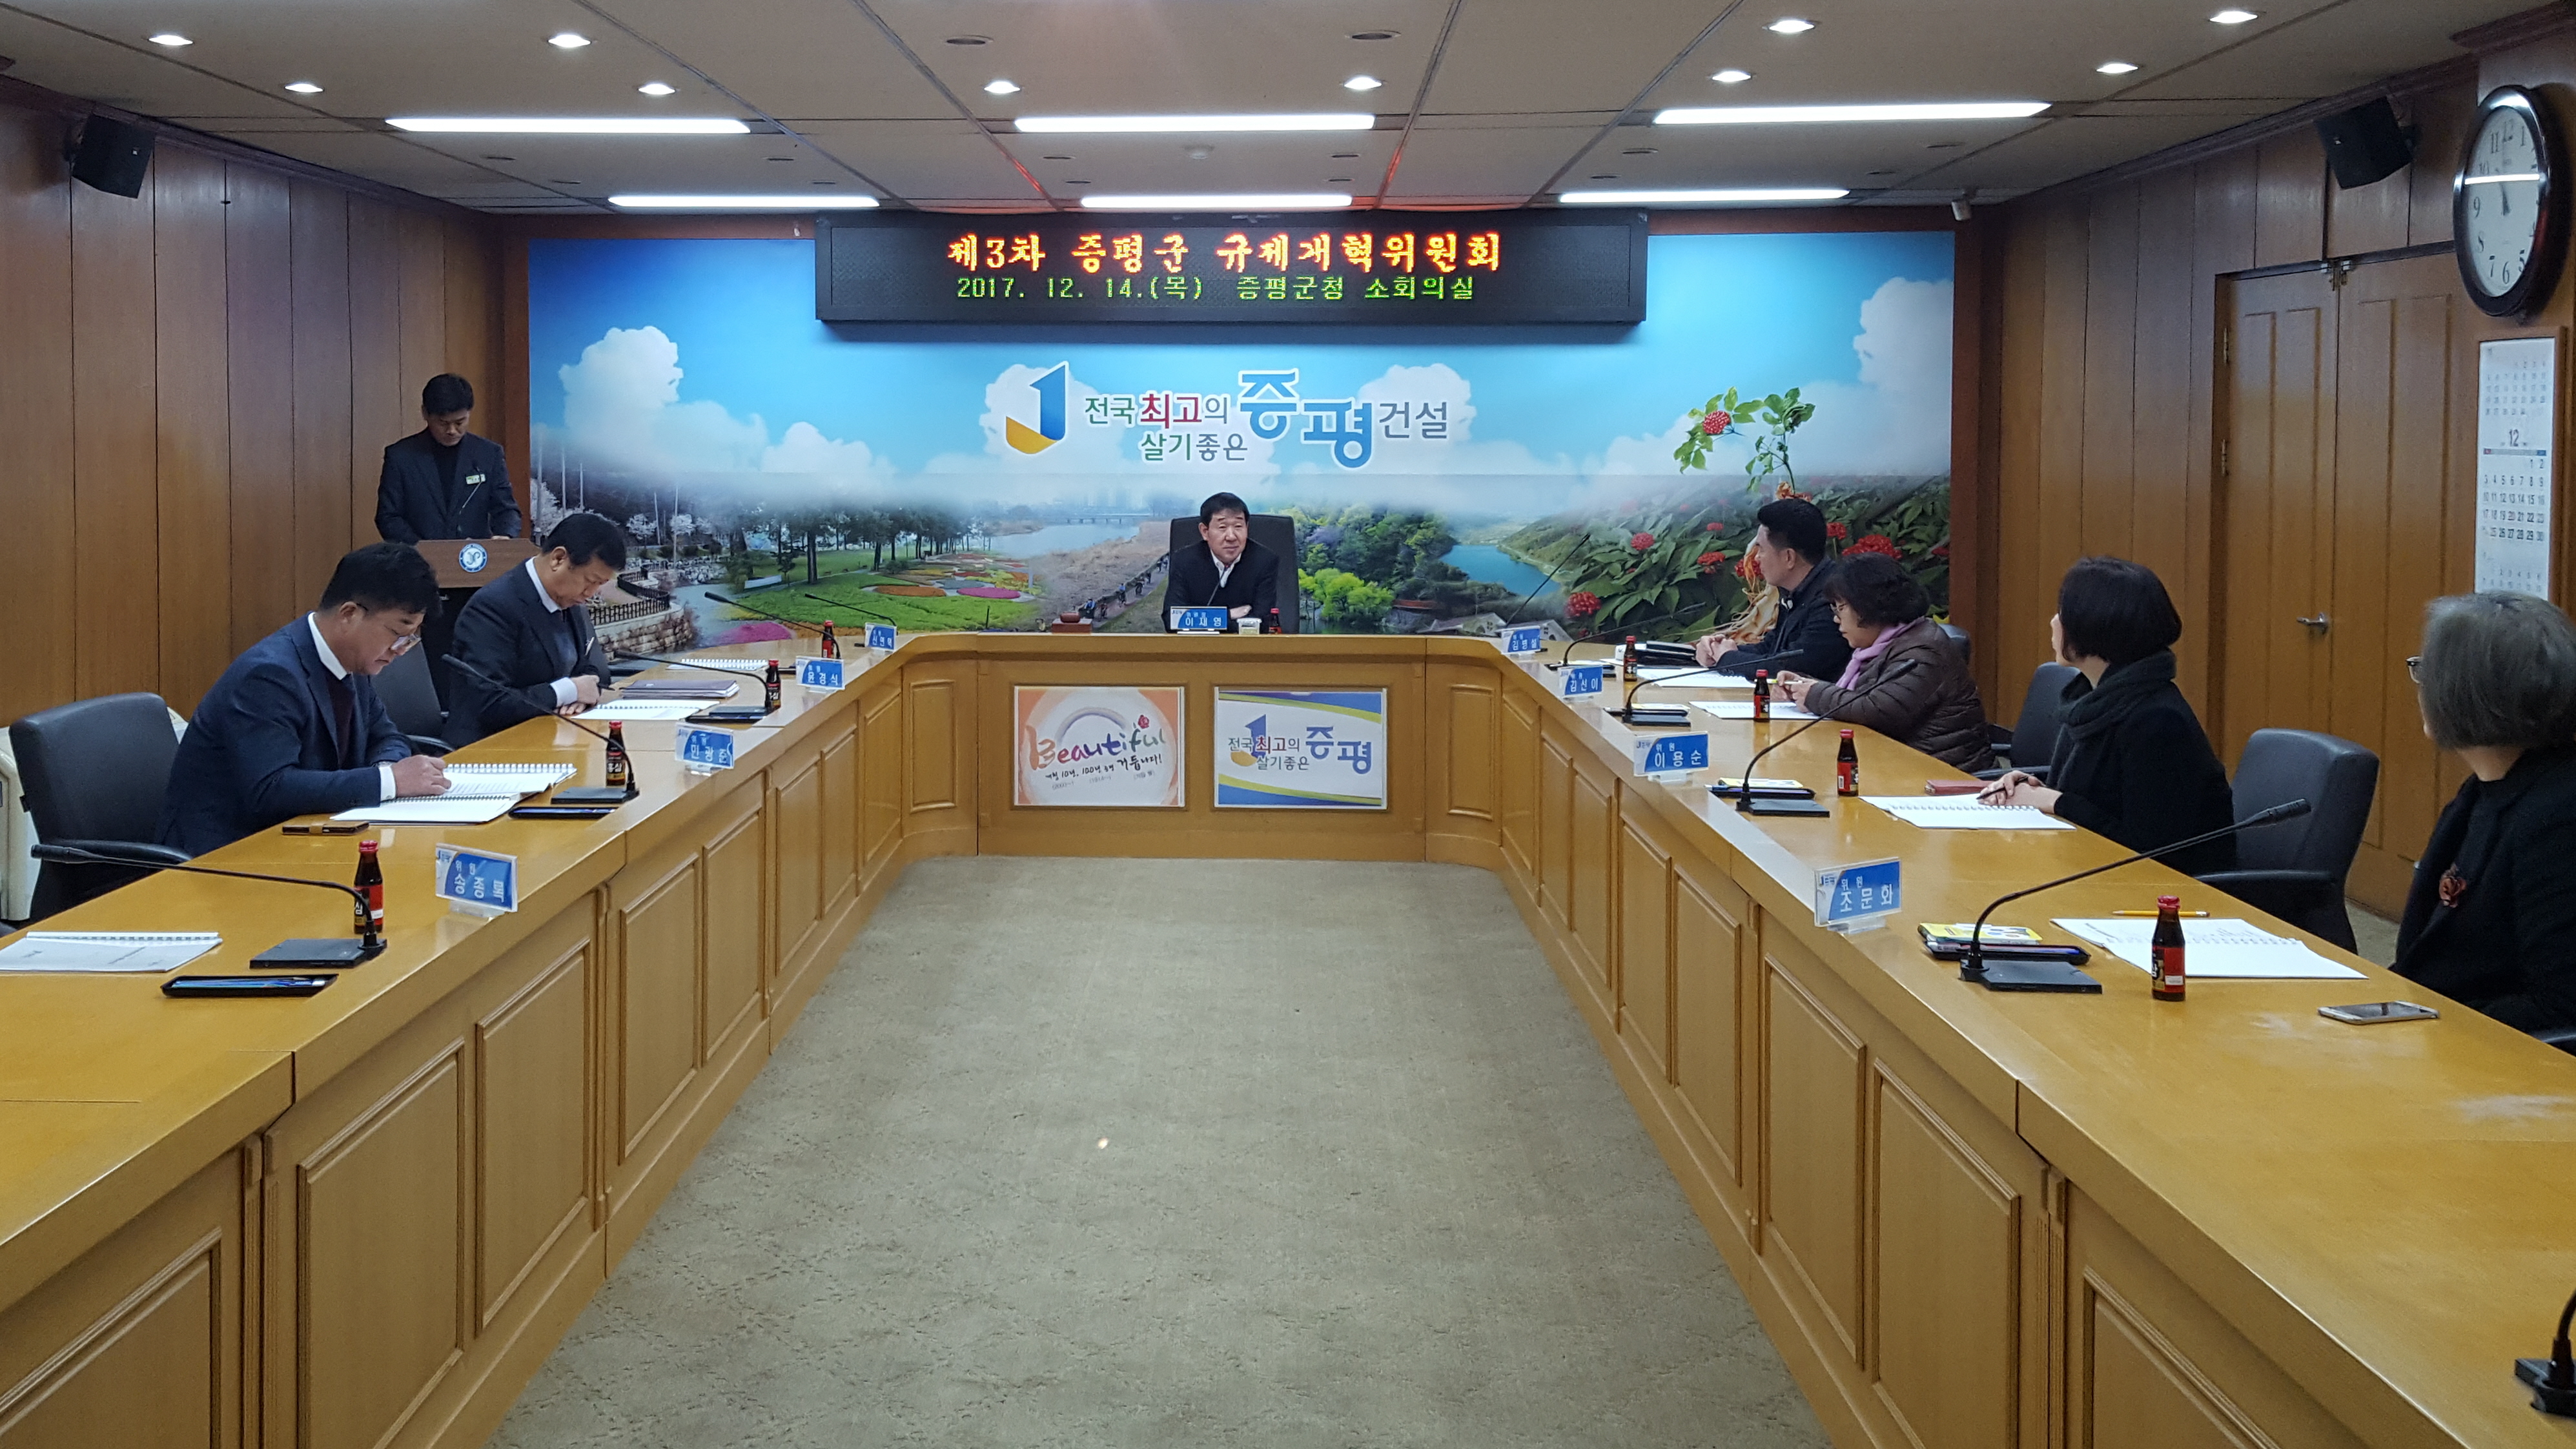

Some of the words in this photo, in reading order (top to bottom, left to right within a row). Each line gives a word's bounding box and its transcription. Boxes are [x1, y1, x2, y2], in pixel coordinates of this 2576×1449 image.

[2473, 196, 2480, 218] 9
[948, 232, 1046, 272] 제3차
[1072, 232, 1189, 274] 증평군
[1216, 232, 1502, 274] 규제개혁위원회
[2489, 255, 2495, 277] 7
[2502, 262, 2510, 284] 6
[957, 276, 1025, 298] 2017.
[1047, 276, 1083, 298] 12.
[1106, 276, 1202, 300] 14.(목)
[1237, 276, 1344, 300] 증평군청
[1365, 276, 1473, 300] 소회의실
[1085, 396, 1135, 424] 전국
[1140, 393, 1228, 428] 최고의
[1239, 371, 1373, 468] 증평
[1378, 401, 1449, 439] 건설
[2509, 429, 2519, 447] 12
[1026, 723, 1166, 770] Beautiful
[1305, 726, 1371, 774] 증평
[1655, 750, 1701, 768] 이용순
[1841, 876, 1863, 891] 위원
[1840, 884, 1893, 912] 조문화
